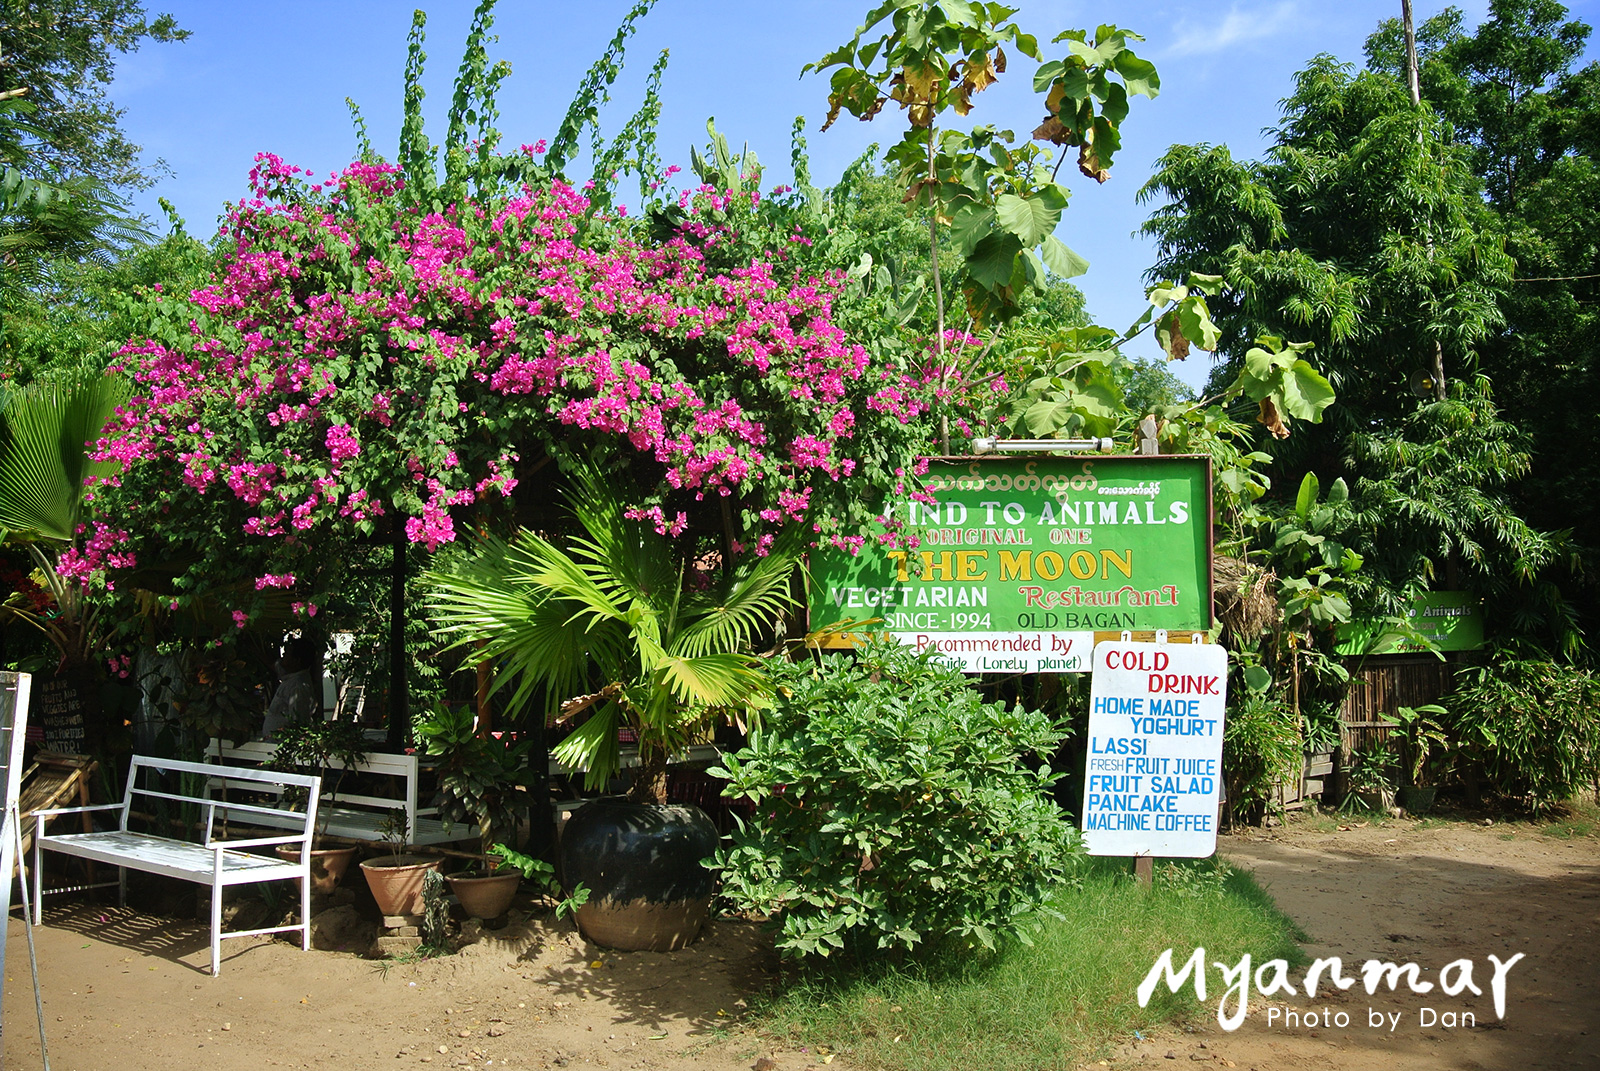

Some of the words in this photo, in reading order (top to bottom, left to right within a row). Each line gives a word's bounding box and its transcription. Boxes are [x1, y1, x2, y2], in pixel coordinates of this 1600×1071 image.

[985, 501, 1026, 526] TO
[1036, 500, 1189, 526] ANIMALS
[926, 527, 1032, 546] ORIGINAL
[1049, 527, 1093, 546] ONE
[887, 549, 989, 582] THE
[998, 549, 1132, 582] MOON
[832, 586, 988, 608] VEGETARIAN
[1018, 585, 1180, 610] Restaurant
[1422, 603, 1472, 618] Animals
[1017, 612, 1059, 629] OLD
[1065, 612, 1136, 629] BAGAN
[1051, 634, 1073, 656] by
[975, 655, 1028, 673] (Lonely
[1036, 656, 1082, 673] planet)
[1105, 650, 1170, 672] COLD
[1148, 674, 1220, 696] DRINK
[1094, 696, 1144, 715] HOME
[1149, 698, 1200, 717] MADE
[1130, 717, 1218, 736] YOGHURT
[1091, 737, 1148, 756] LASSI
[1090, 758, 1125, 772] FRESH
[1126, 757, 1171, 775] FRUIT
[1173, 758, 1216, 776] JUICE
[1089, 775, 1143, 793] FRUIT
[1151, 777, 1213, 795] SALAD
[1088, 794, 1179, 813] PANCAKE
[1086, 813, 1151, 831] MACHINE
[1155, 814, 1212, 832] COFFEE
